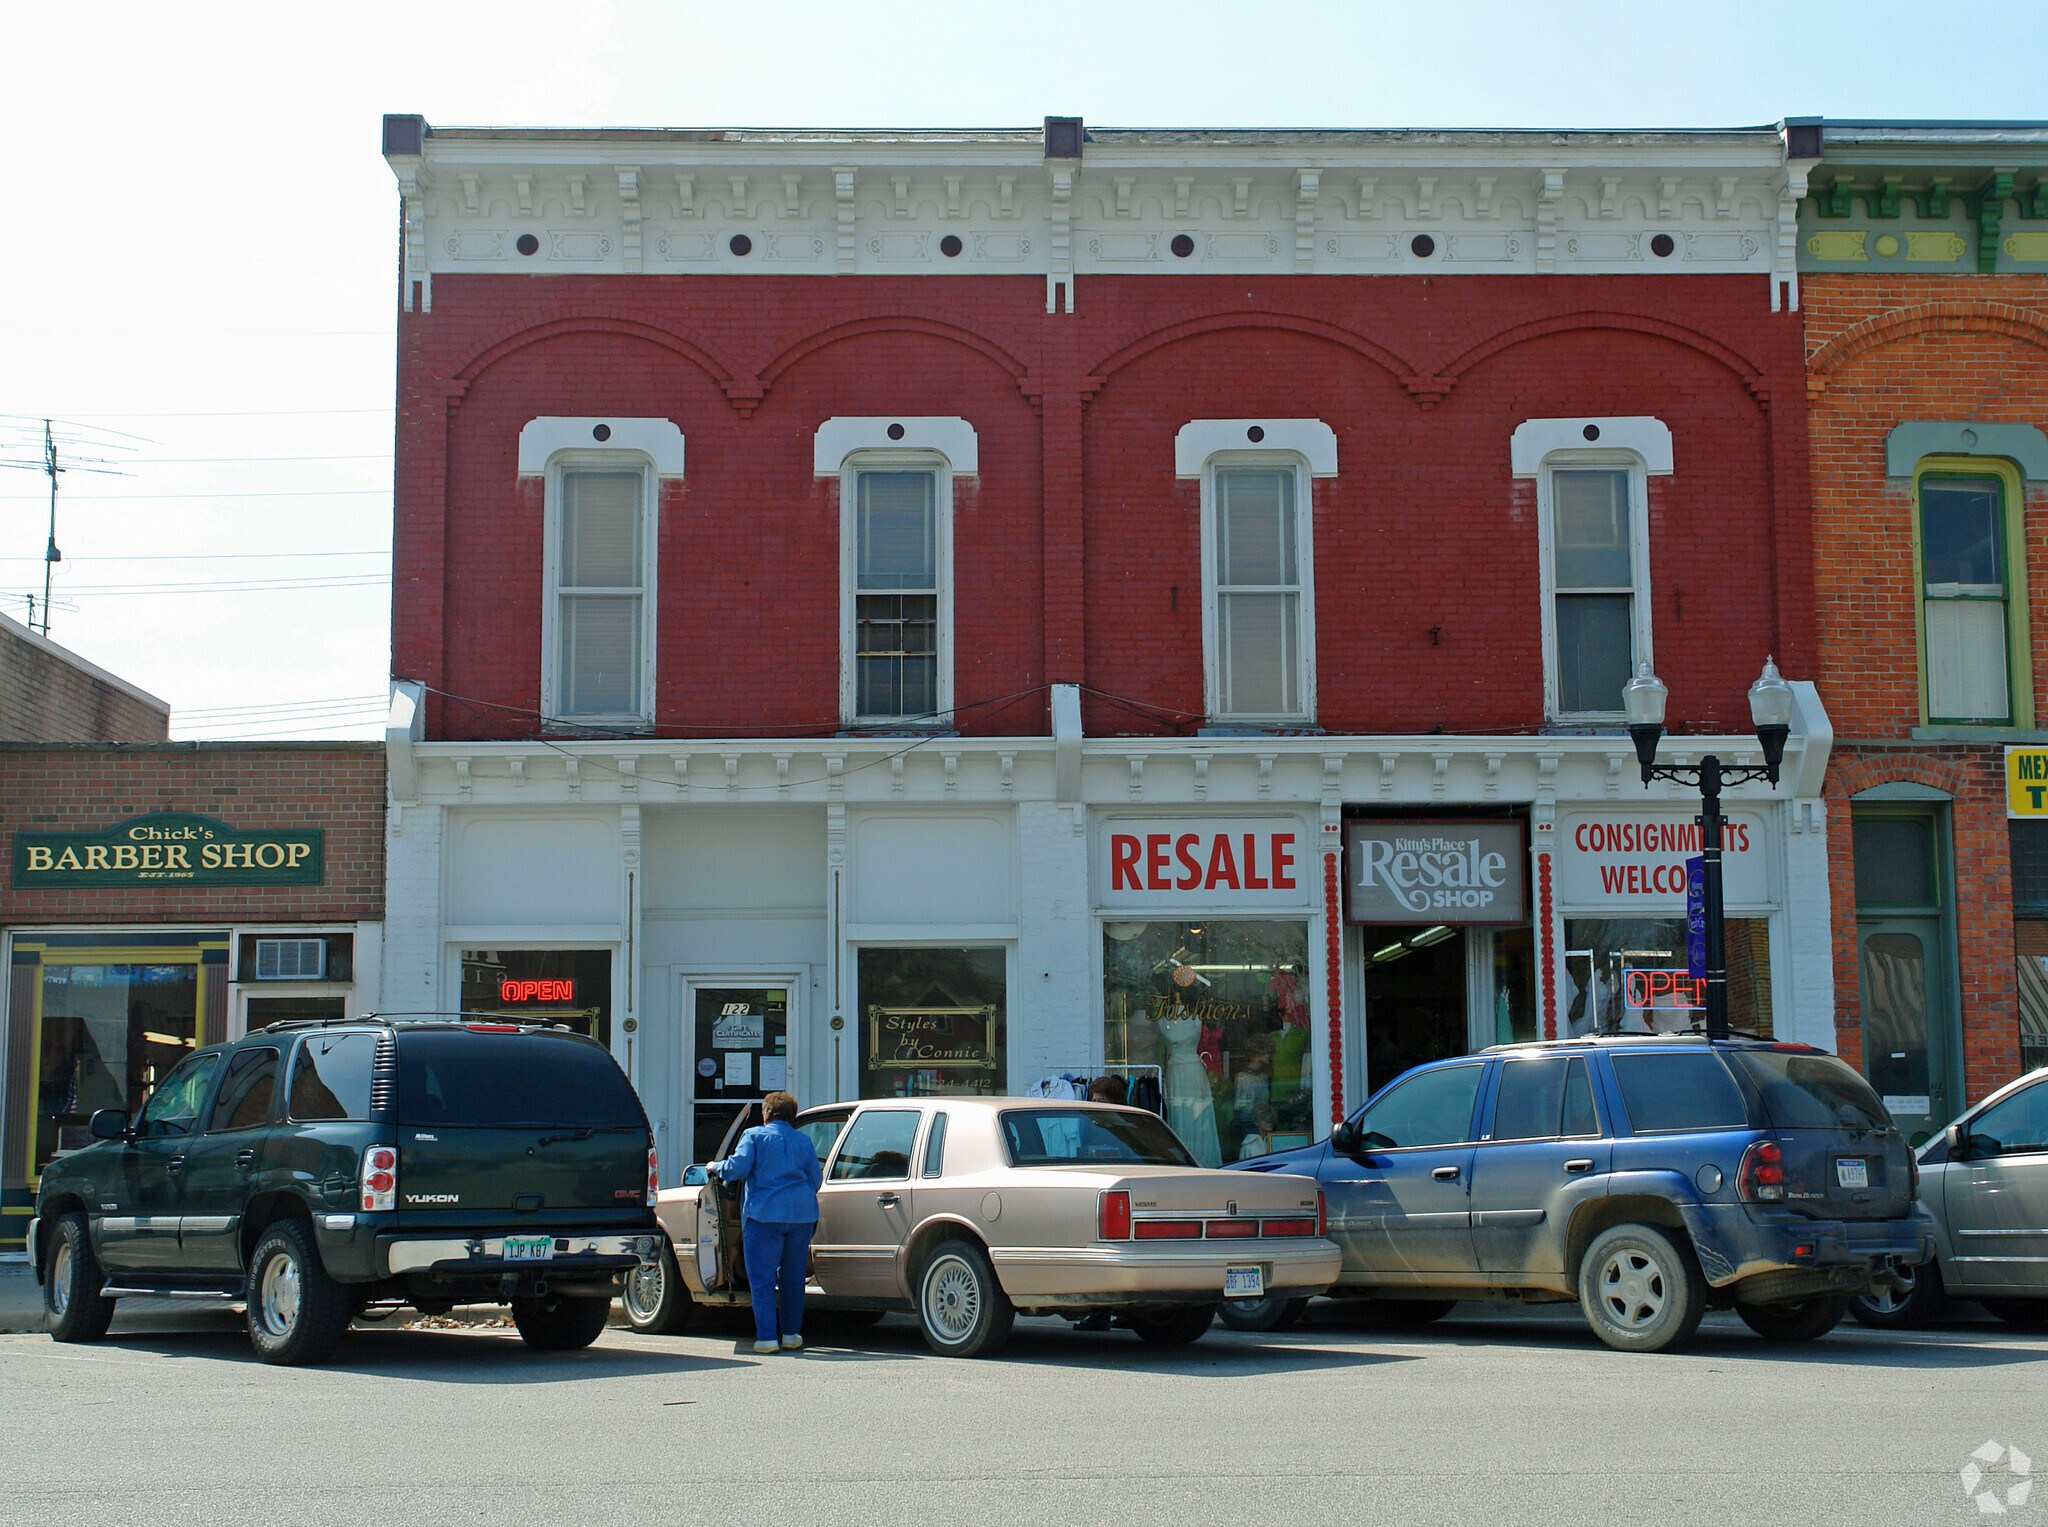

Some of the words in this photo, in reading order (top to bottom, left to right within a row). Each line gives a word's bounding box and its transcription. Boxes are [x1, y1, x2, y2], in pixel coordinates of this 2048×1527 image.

[2025, 786, 2048, 808] T
[128, 827, 214, 841] Chick's
[1395, 838, 1431, 853] Kitty's
[1432, 838, 1465, 851] Place
[27, 844, 192, 871] BARBER
[201, 843, 310, 869] SHOP
[1111, 833, 1296, 890] RESALE
[1358, 838, 1506, 912] Resale
[1600, 865, 1686, 894] WELCO
[1433, 890, 1494, 908] SHOP
[501, 980, 574, 1002] OPEN
[725, 1004, 748, 1014] 122
[1146, 994, 1252, 1021] Fashions
[886, 1016, 938, 1033] Styles
[900, 1033, 919, 1048] by
[918, 1045, 980, 1059] Connie
[405, 1194, 459, 1203] YUKON
[614, 1189, 640, 1199] GMC
